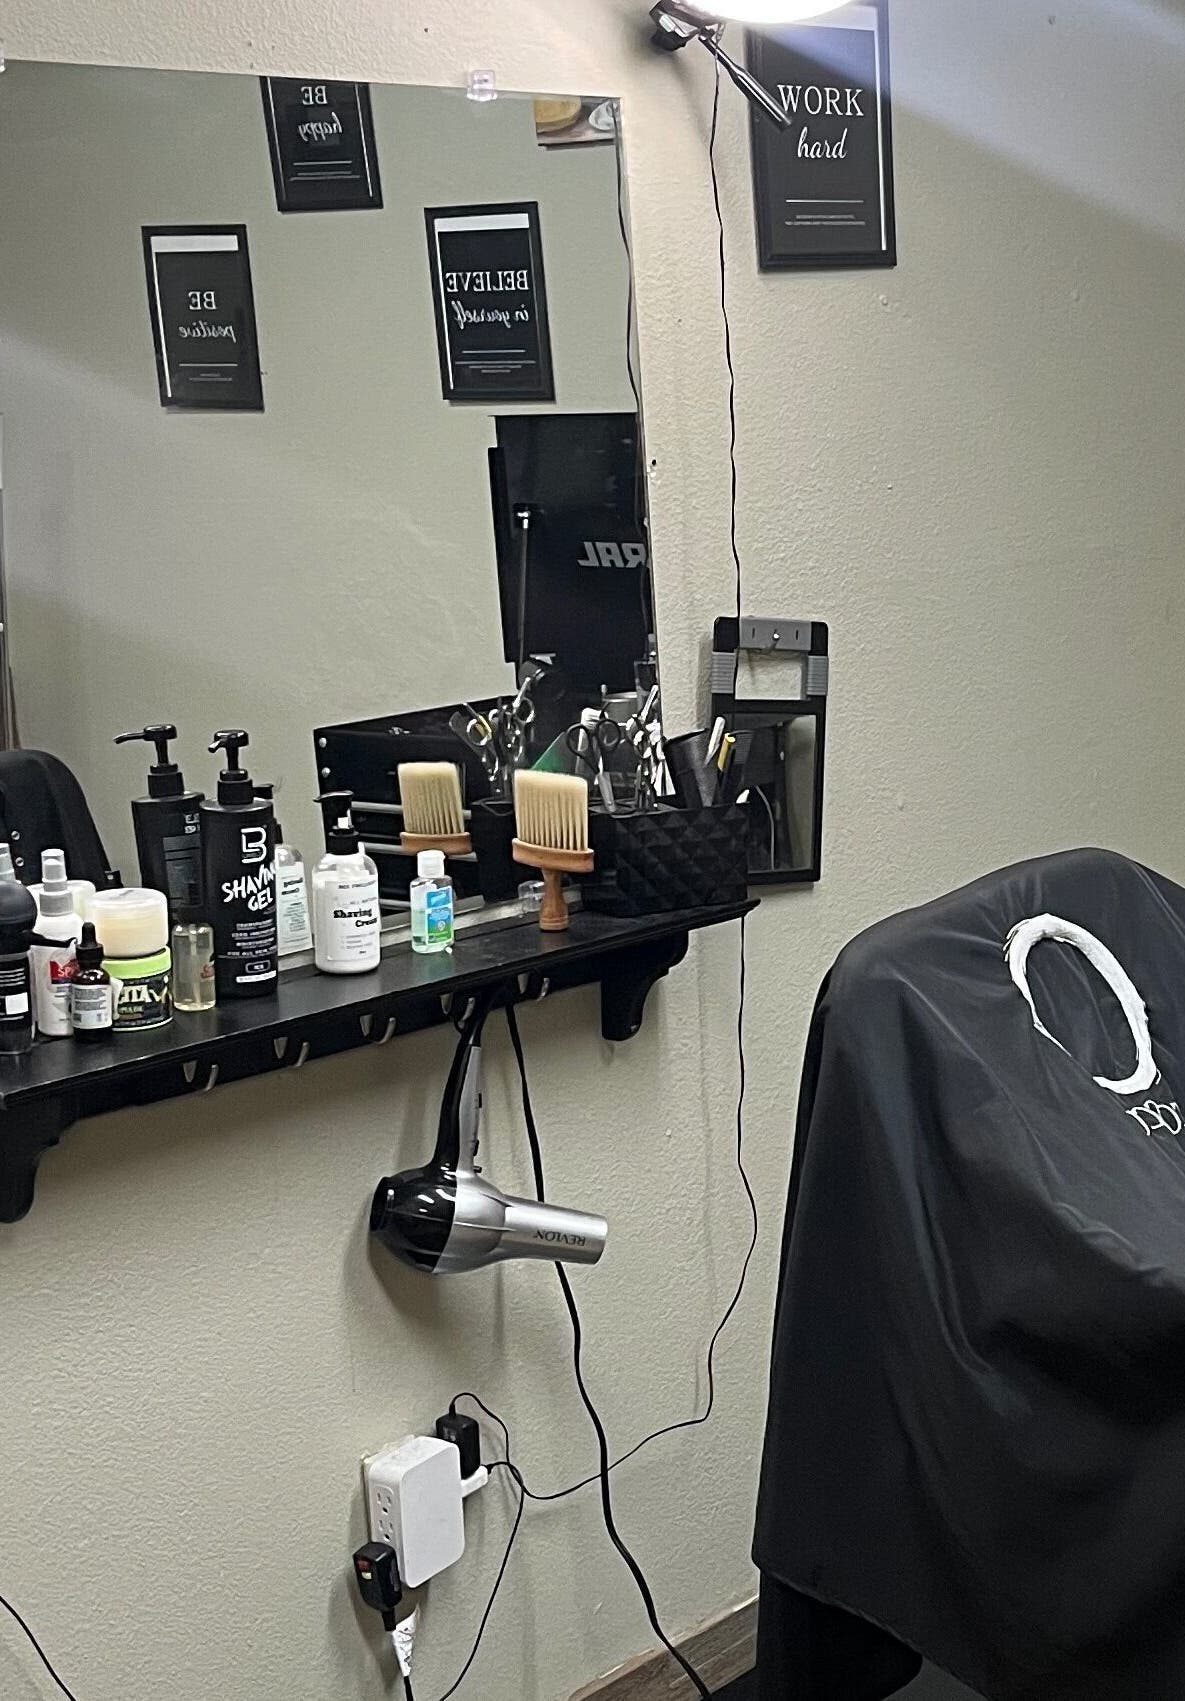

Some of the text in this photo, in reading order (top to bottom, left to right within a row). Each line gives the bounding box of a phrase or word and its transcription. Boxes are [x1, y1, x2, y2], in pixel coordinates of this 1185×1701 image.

[777, 84, 865, 116] WORK
[797, 126, 849, 159] hard
[247, 886, 273, 912] GEL
[534, 1229, 586, 1247] REVLON
